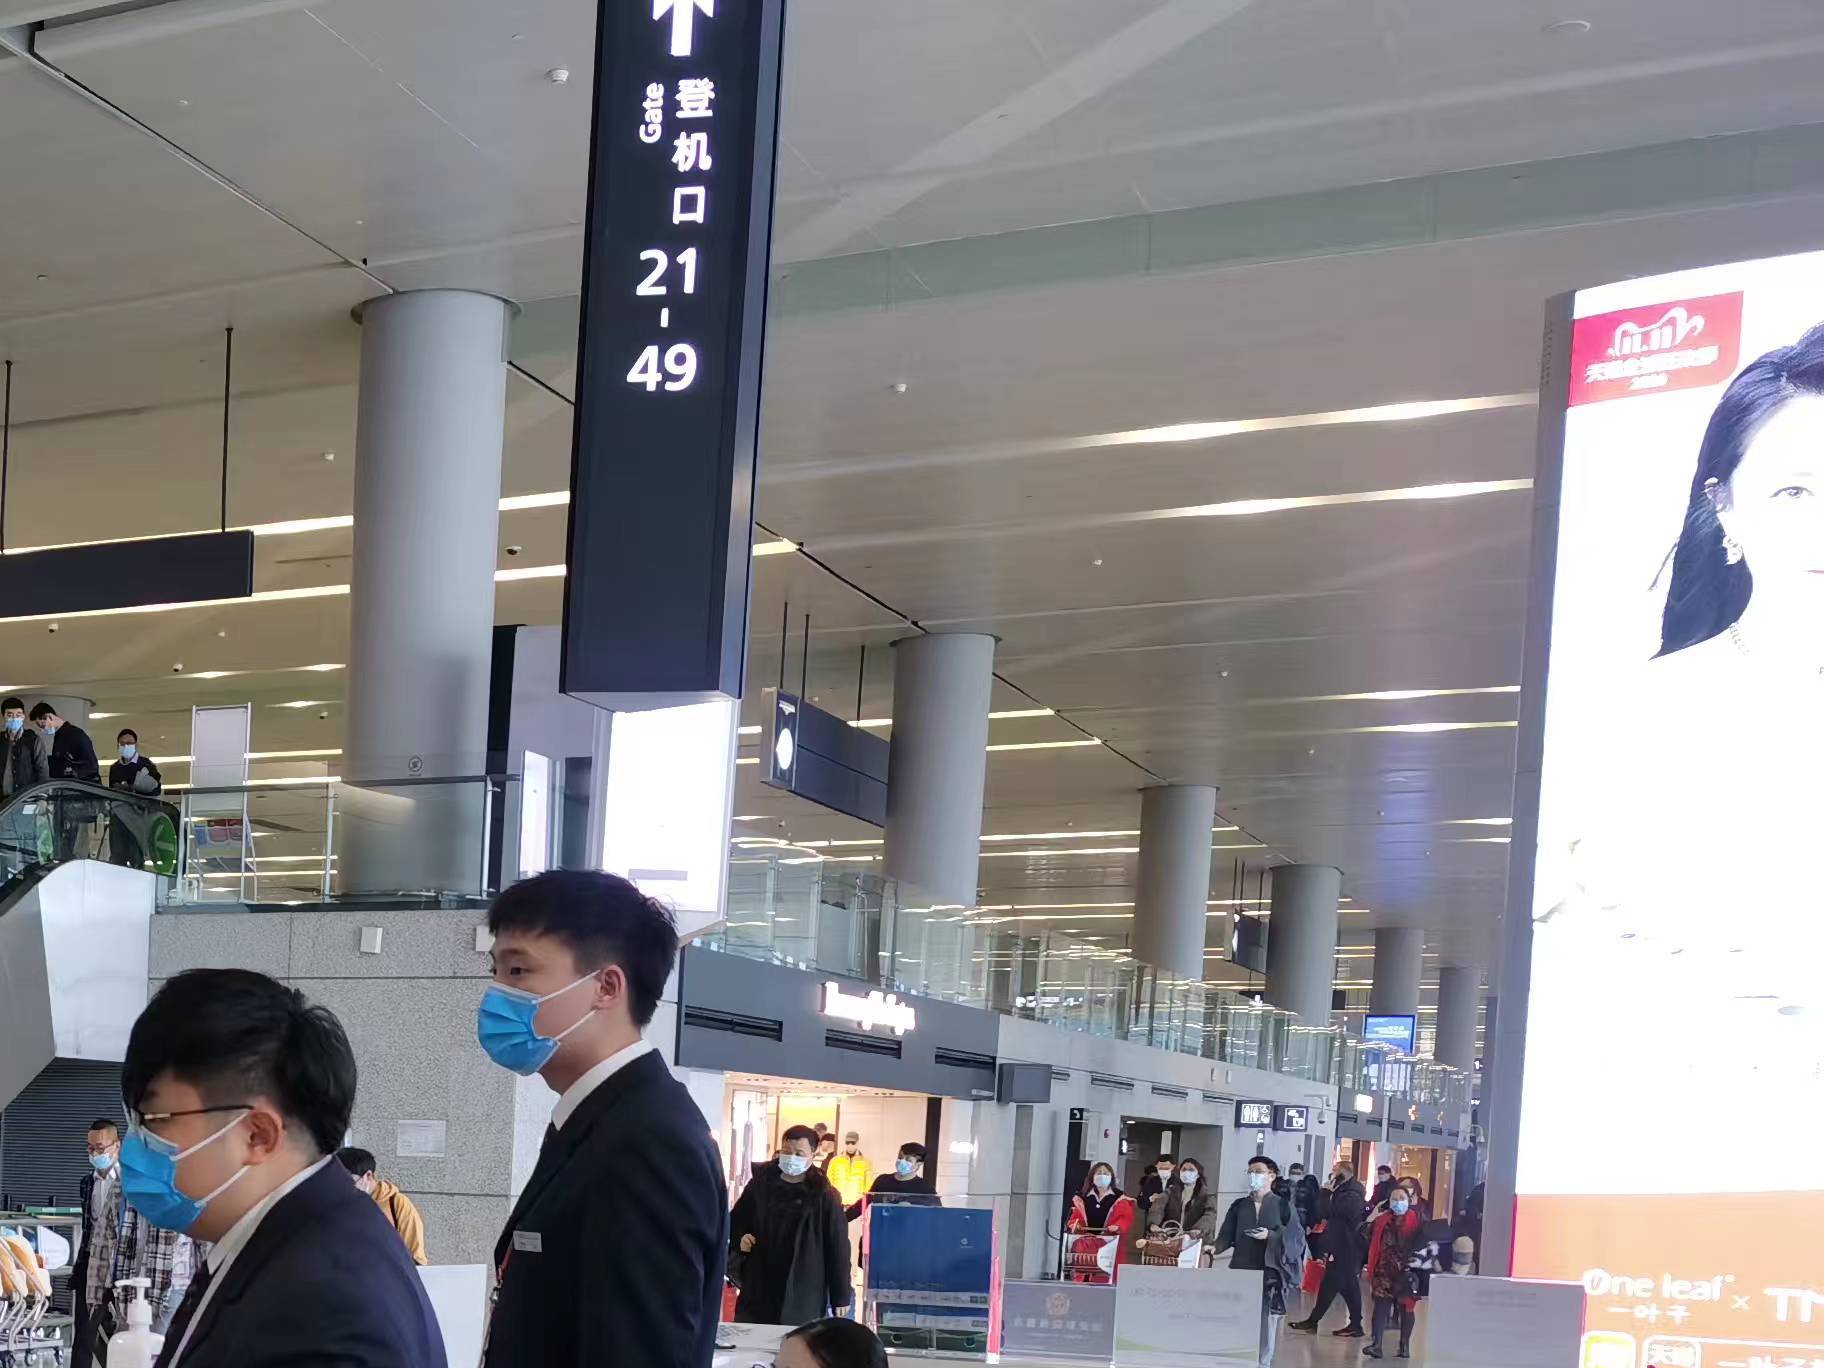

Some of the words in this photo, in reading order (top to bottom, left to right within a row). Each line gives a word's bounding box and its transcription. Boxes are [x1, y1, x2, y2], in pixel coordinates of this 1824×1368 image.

[639, 82, 665, 144] Gate
[671, 77, 716, 225] 登机口
[635, 247, 698, 297] 21
[626, 343, 698, 392] 49
[1583, 1268, 1655, 1298] One
[1661, 1271, 1724, 1302] leaf
